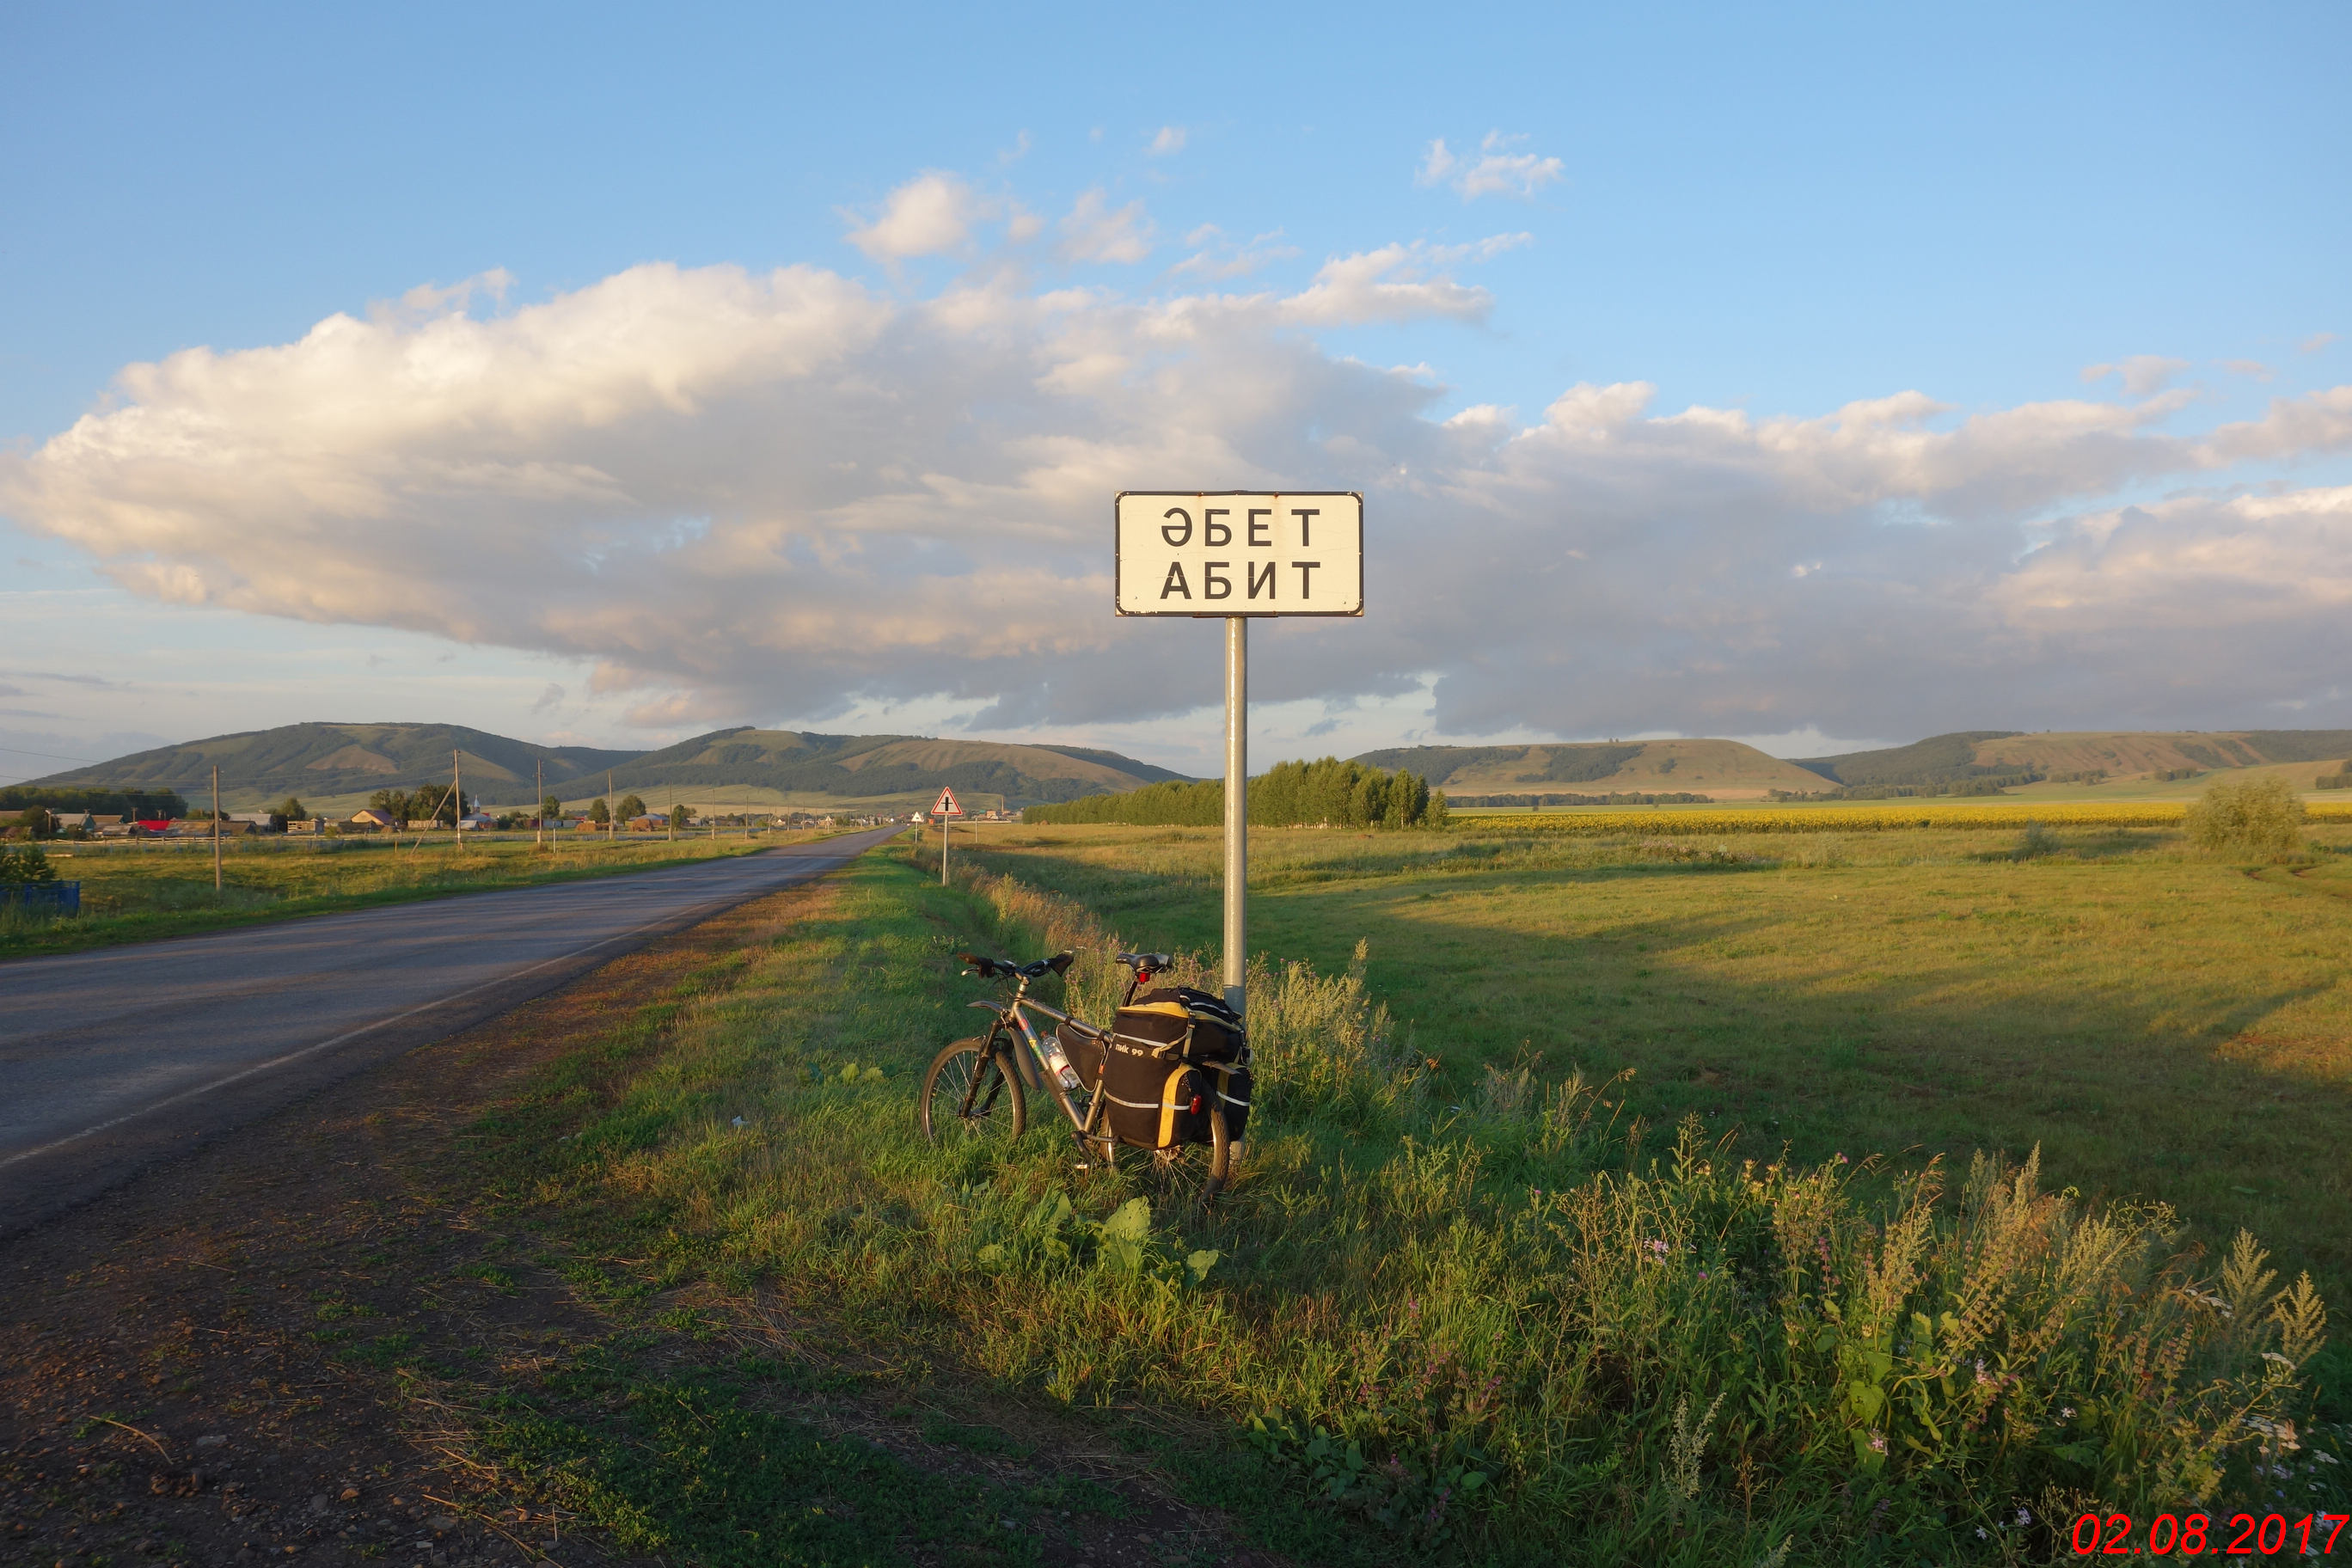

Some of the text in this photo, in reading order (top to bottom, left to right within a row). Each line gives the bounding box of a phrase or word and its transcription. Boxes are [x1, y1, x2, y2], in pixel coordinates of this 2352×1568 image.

[1161, 507, 1320, 547] ӘБЕТ
[1161, 561, 1320, 599] АБИТ
[1131, 1048, 1144, 1057] 99
